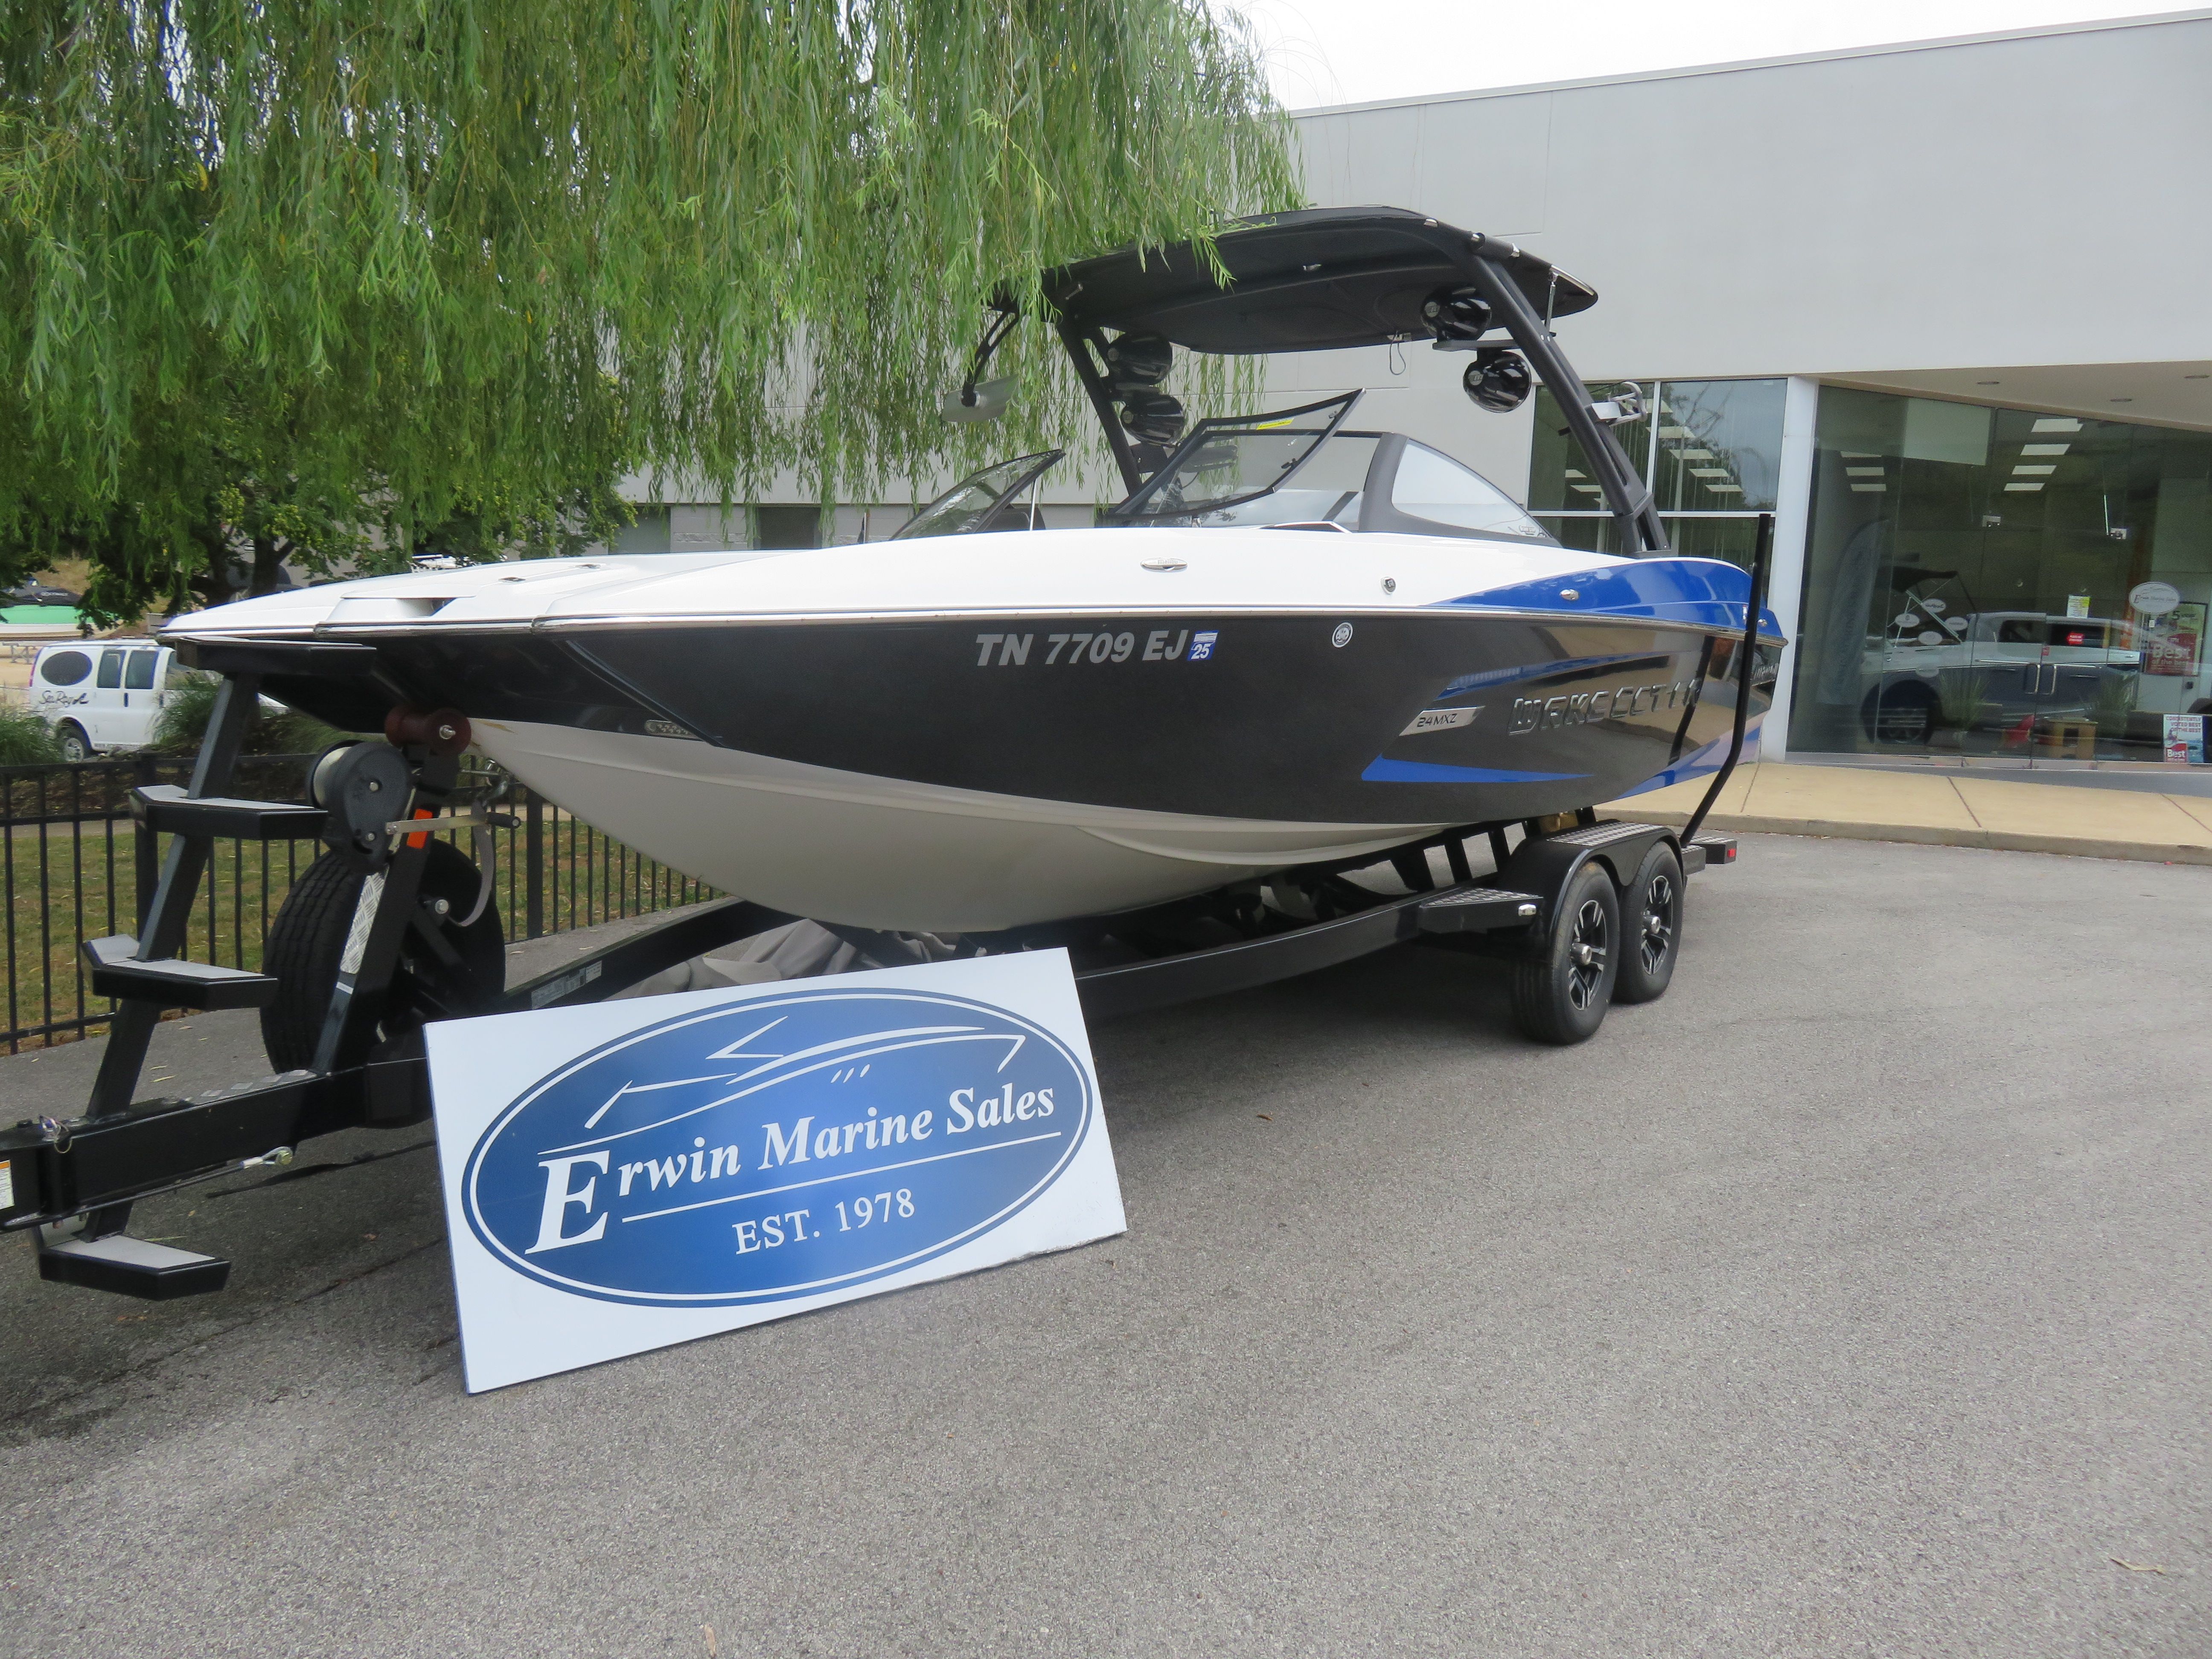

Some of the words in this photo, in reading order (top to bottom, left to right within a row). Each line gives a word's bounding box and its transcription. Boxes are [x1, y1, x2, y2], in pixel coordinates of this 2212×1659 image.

[975, 633, 1034, 666] TN
[1045, 631, 1135, 664] 7709
[1141, 629, 1189, 661] EJ
[1190, 643, 1211, 660] 25
[2167, 749, 2186, 758] Best
[524, 1136, 741, 1254] Erwin
[757, 1106, 933, 1170] Marine
[946, 1082, 1055, 1135] Sales
[731, 1208, 821, 1255] EST.
[834, 1187, 915, 1232] 1978
